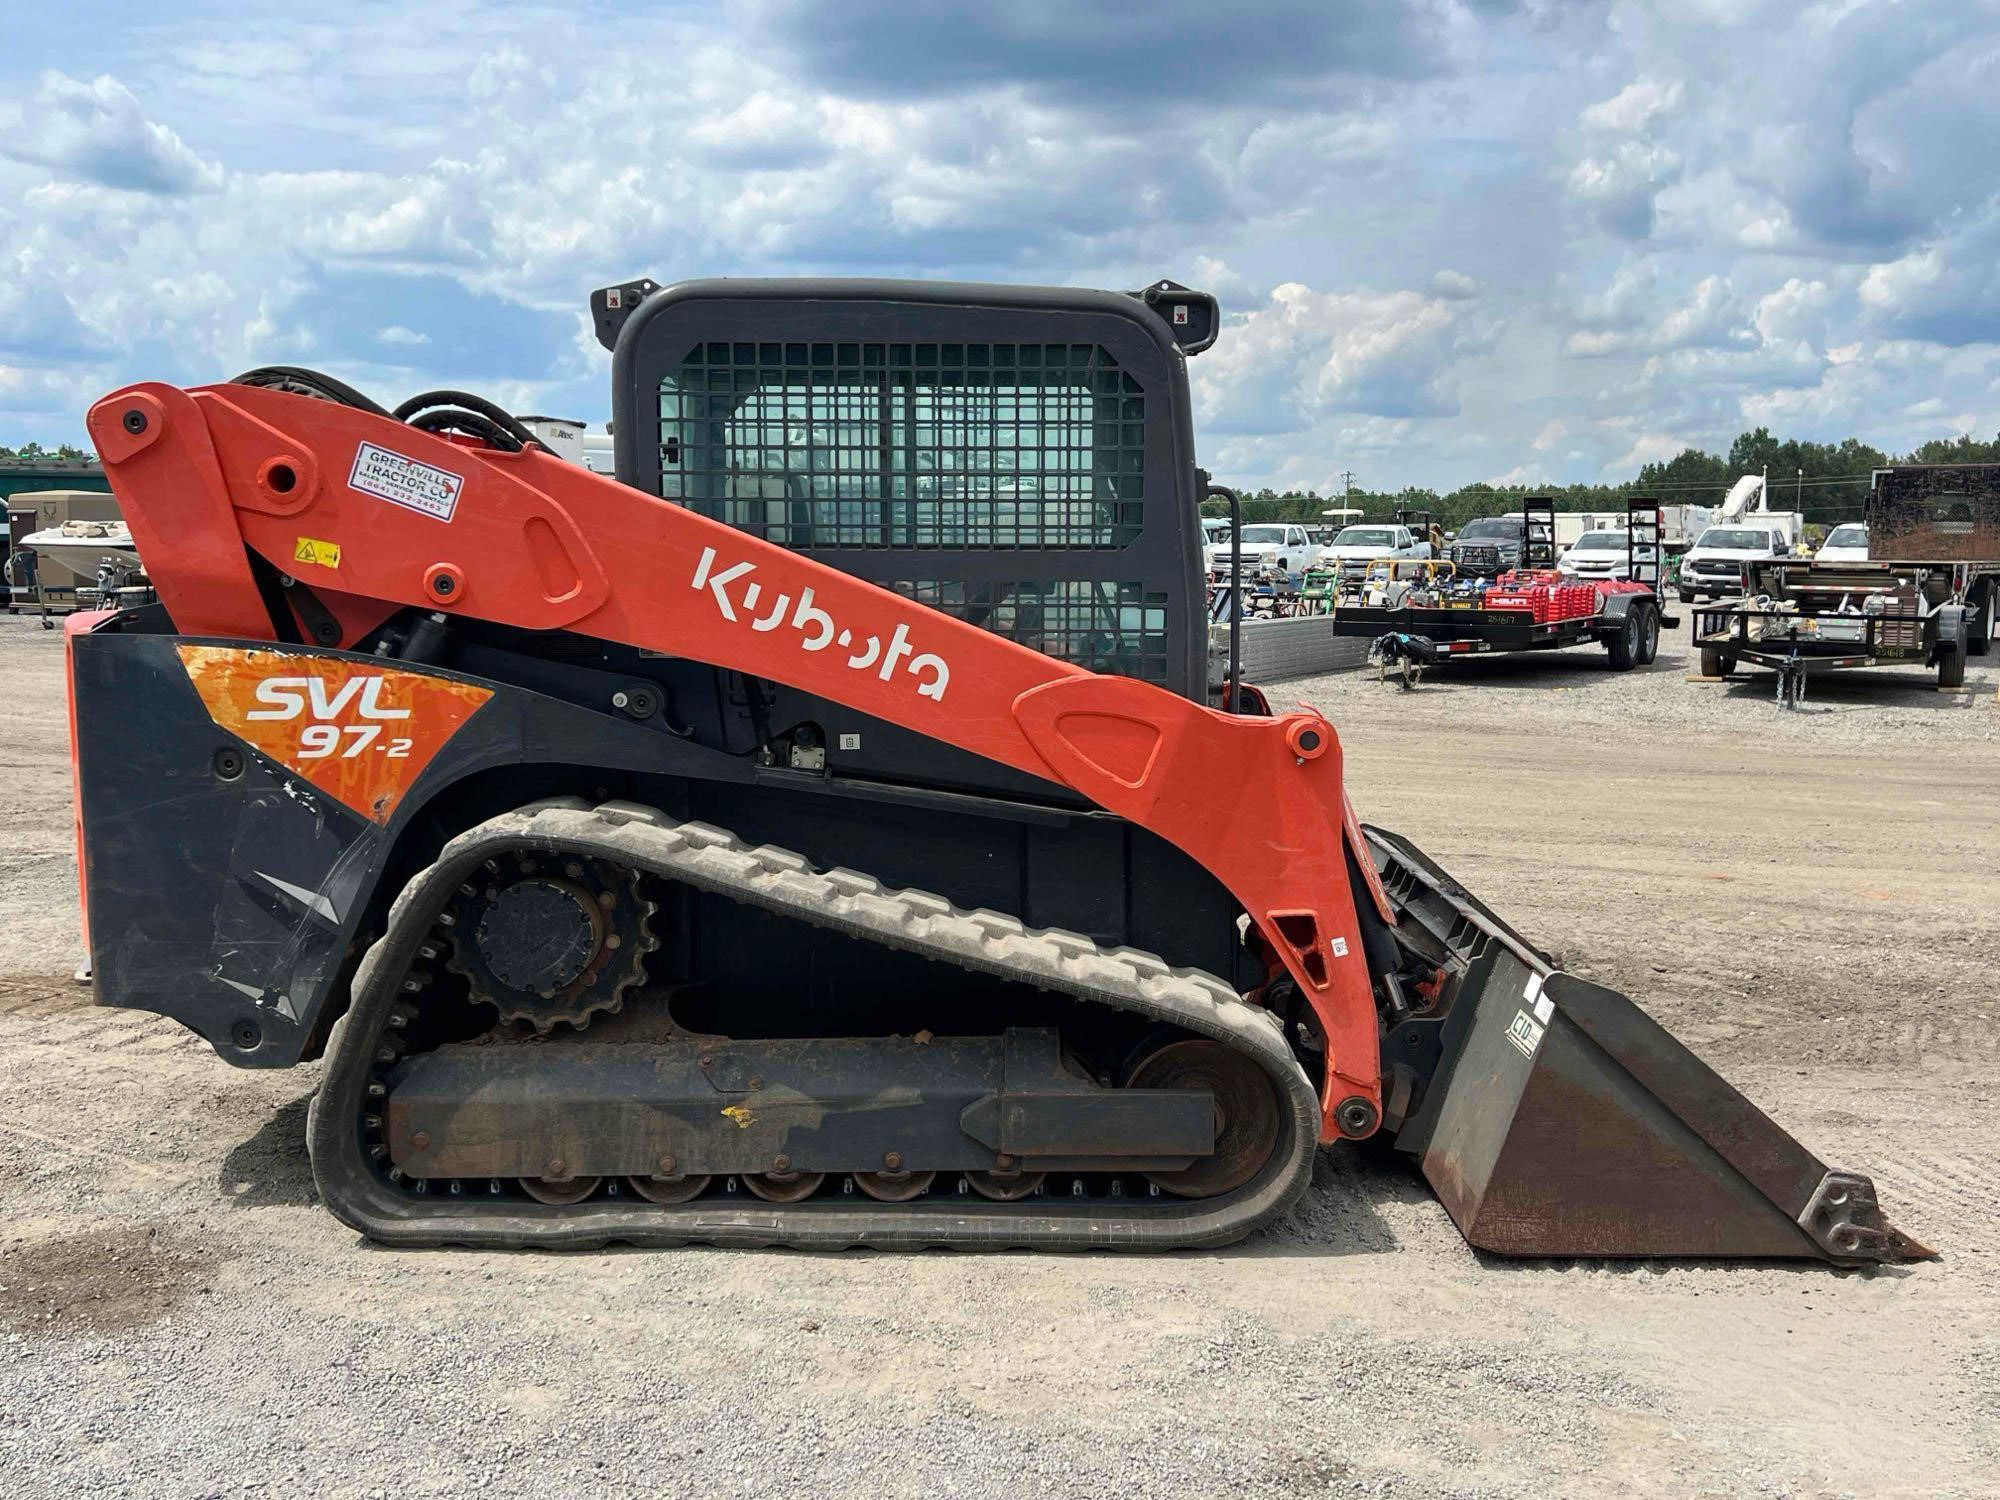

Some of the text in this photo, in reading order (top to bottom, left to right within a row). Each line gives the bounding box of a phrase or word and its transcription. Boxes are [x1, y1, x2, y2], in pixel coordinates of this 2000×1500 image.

[365, 464, 426, 493] TRACTOR
[370, 451, 451, 487] GREENVILLE
[359, 471, 450, 507] SALES SERVICE RENTALS
[1491, 597, 1527, 605] HILTI
[691, 546, 950, 702] Kubota
[246, 676, 411, 720] SVL
[297, 725, 413, 758] 97-2
[1512, 1015, 1533, 1041] CID
